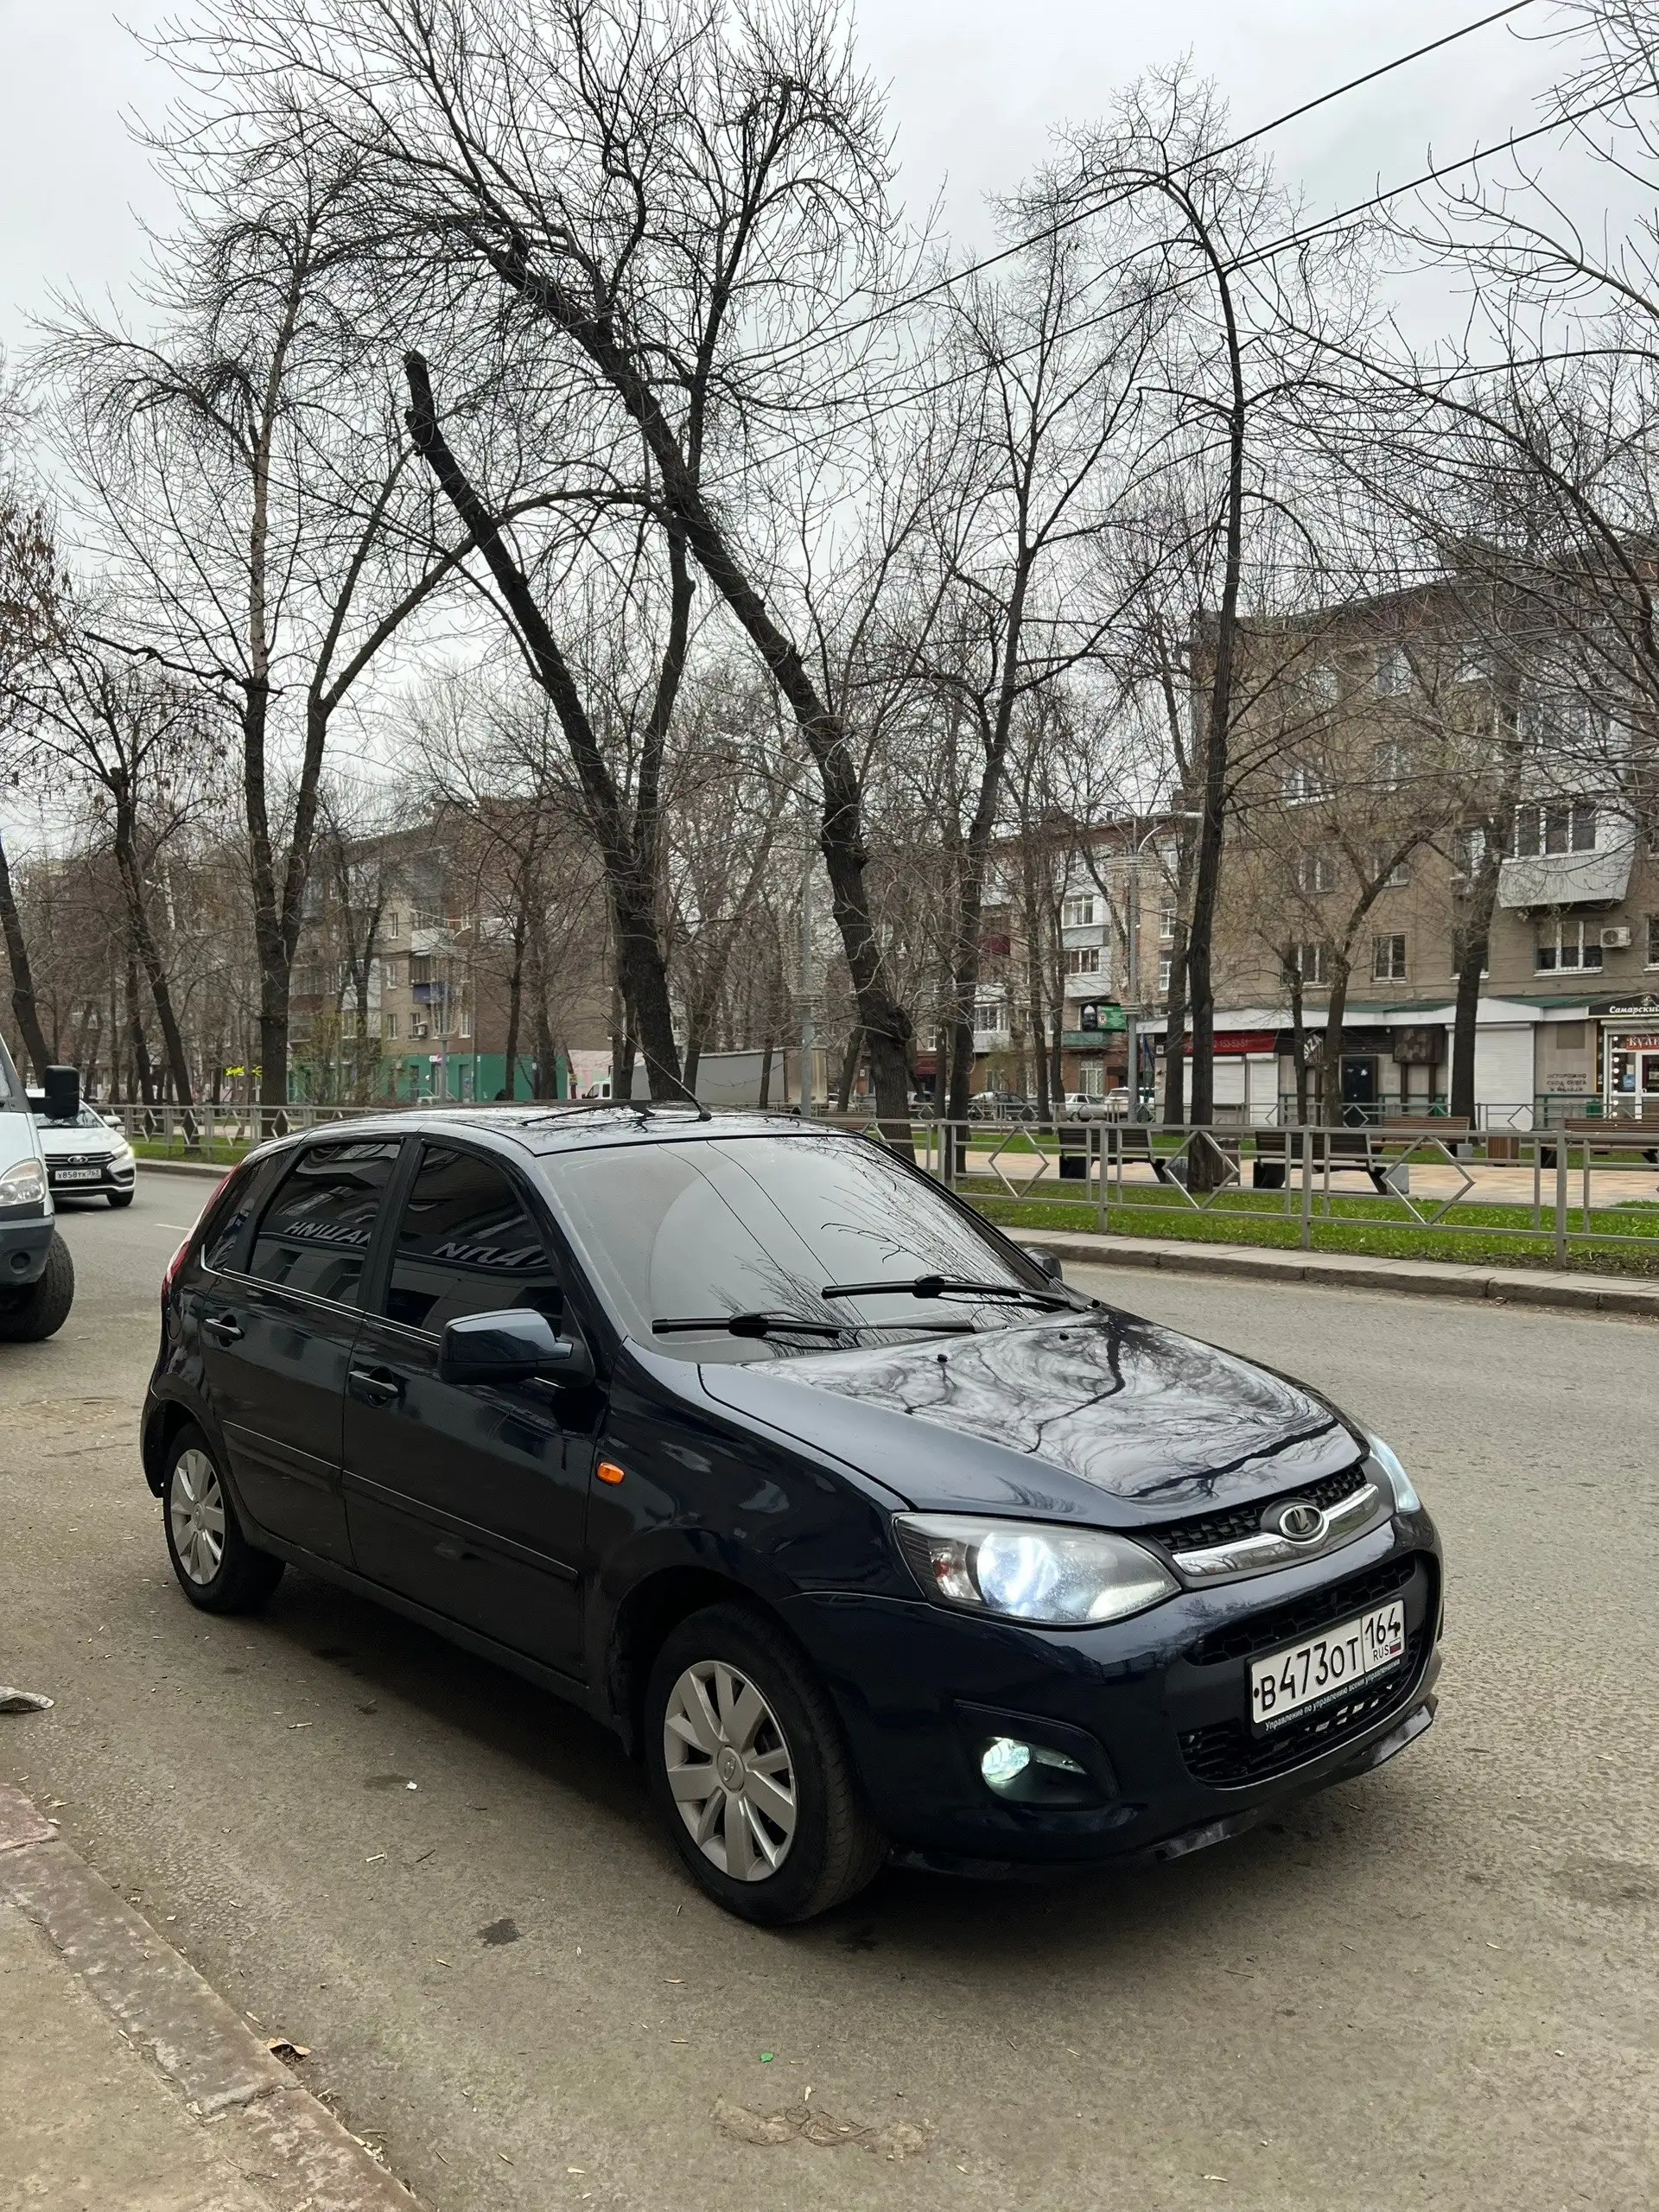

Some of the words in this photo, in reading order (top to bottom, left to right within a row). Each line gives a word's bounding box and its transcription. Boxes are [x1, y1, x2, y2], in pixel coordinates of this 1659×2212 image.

[1260, 1636, 1359, 1713] В473ОТ
[1364, 1607, 1402, 1649] 164
[1373, 1644, 1389, 1663] RUS
[1265, 1708, 1304, 1732] Управление
[1304, 1704, 1313, 1714] по
